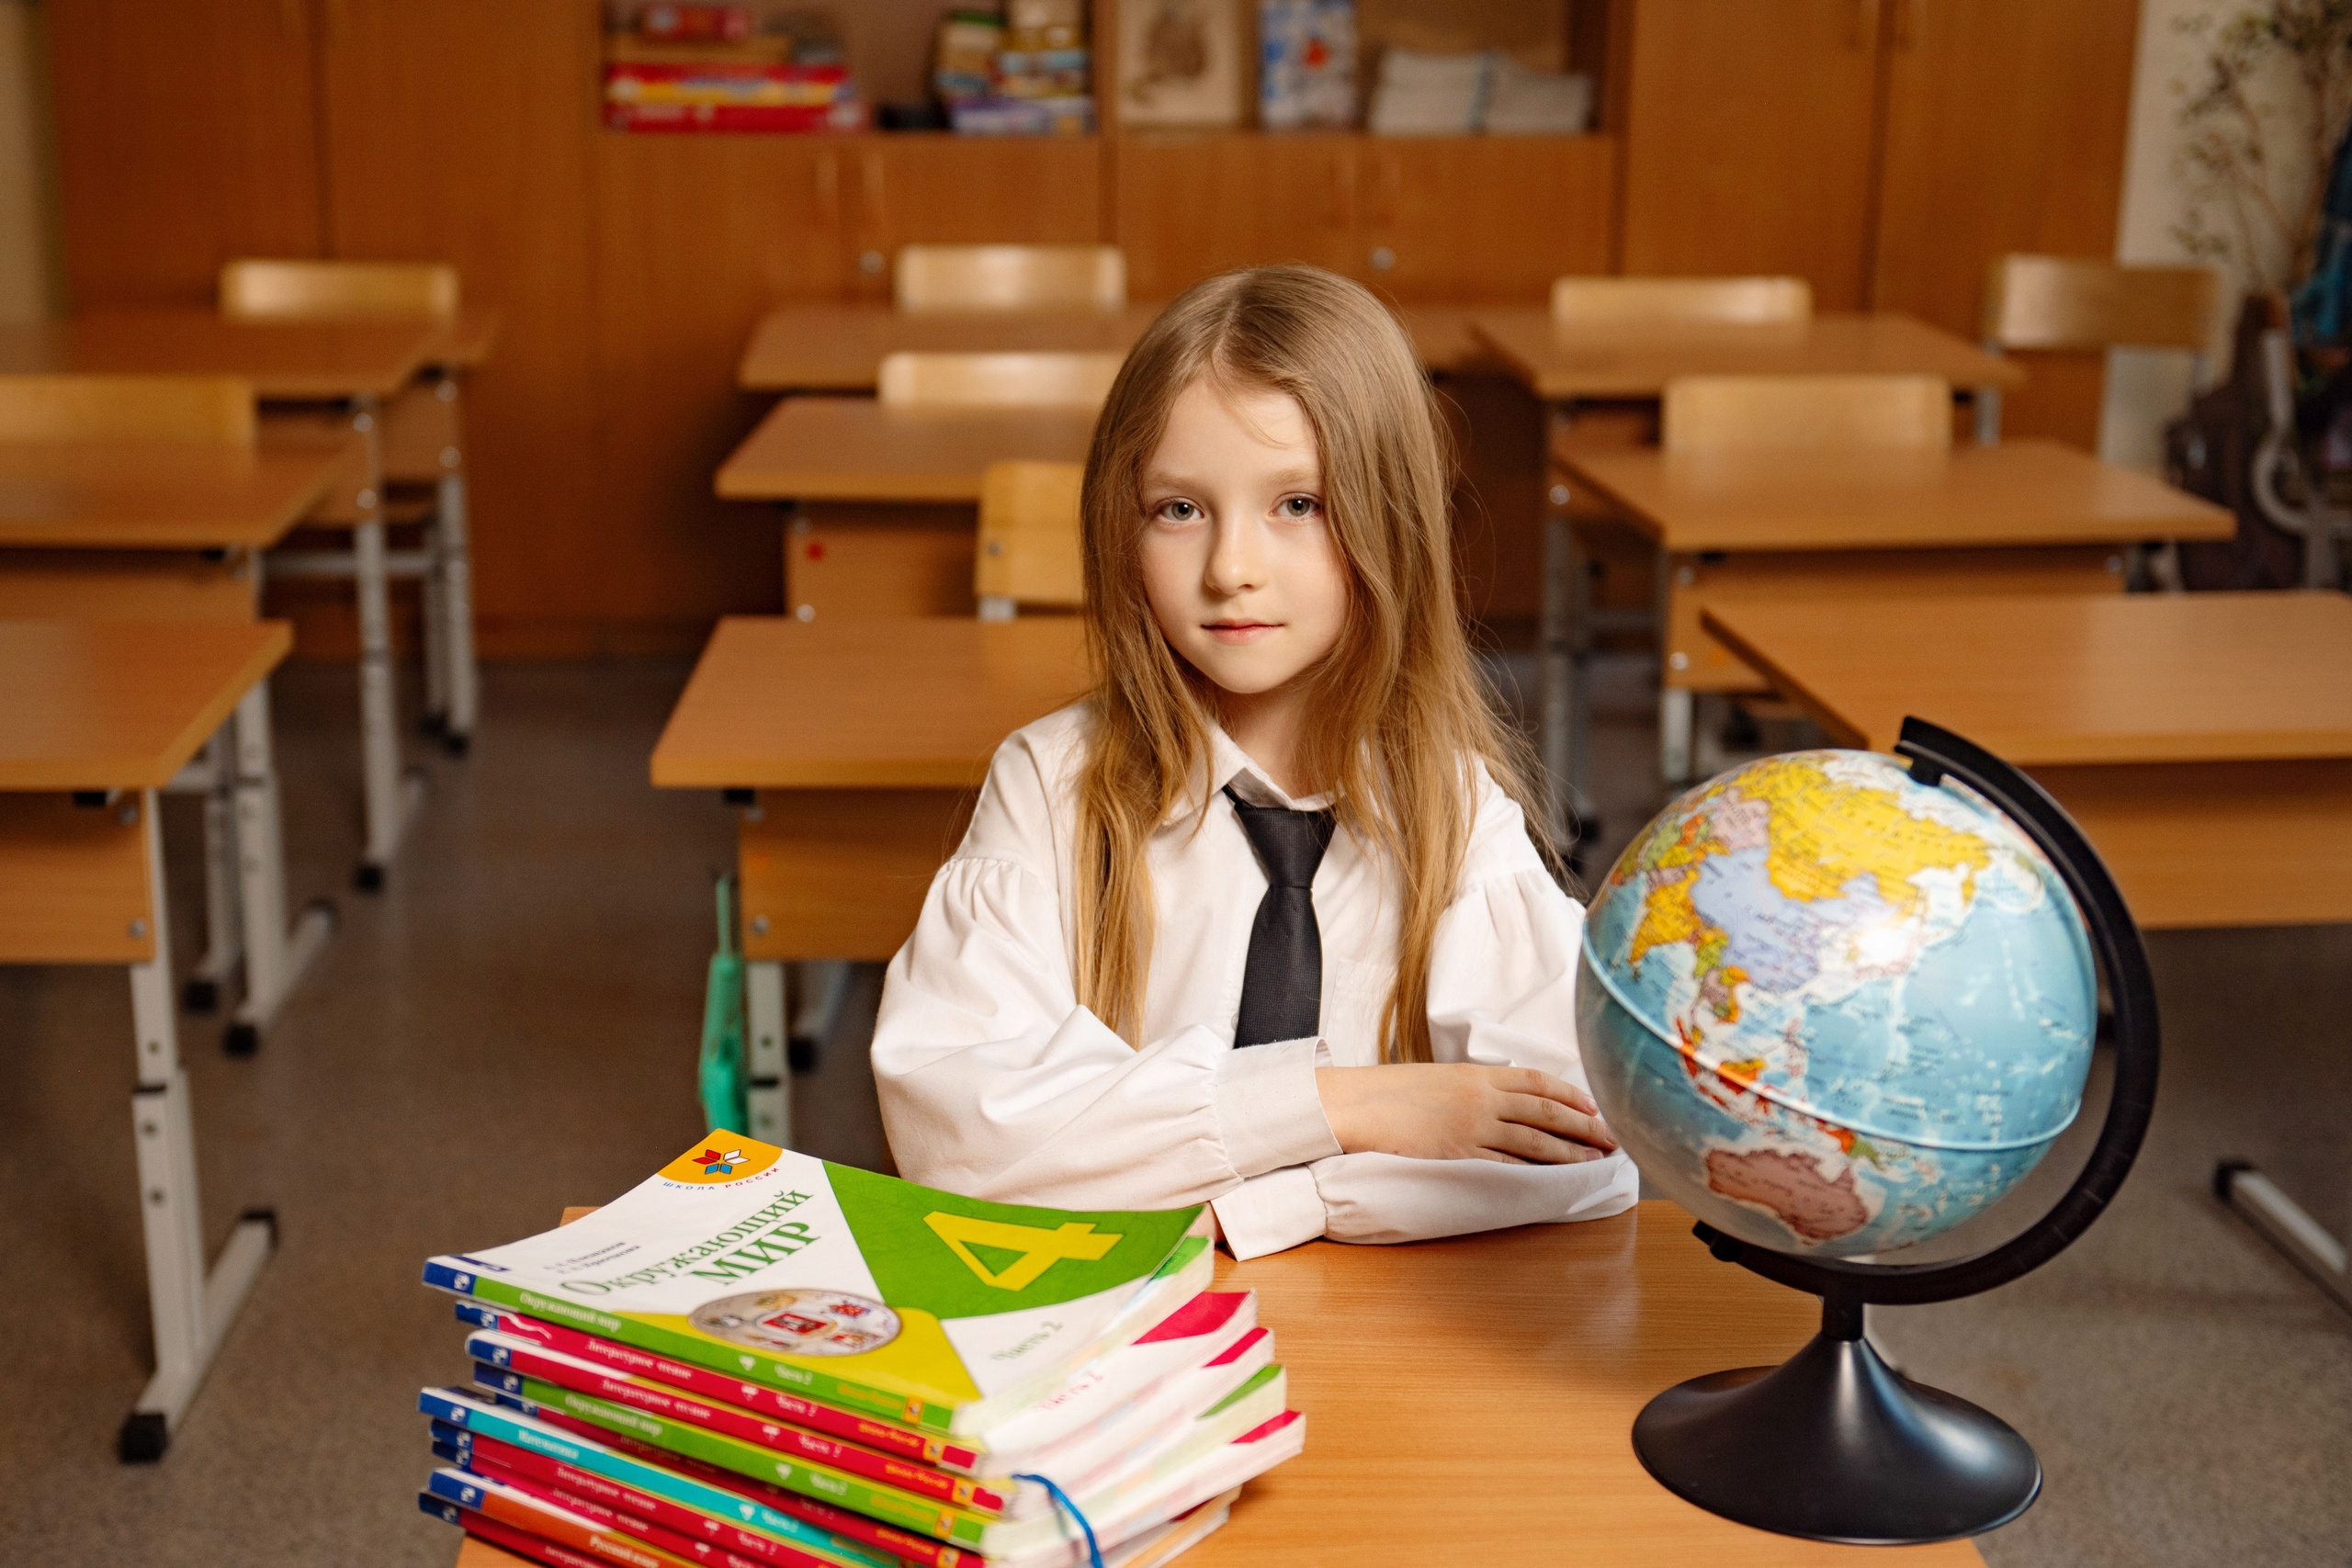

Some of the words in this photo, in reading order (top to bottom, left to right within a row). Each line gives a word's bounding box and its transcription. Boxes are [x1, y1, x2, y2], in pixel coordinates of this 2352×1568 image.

[662, 1181, 716, 1191] ШКОЛА
[724, 1167, 780, 1189] РОССИИ
[559, 1190, 814, 1296] Окружающий
[684, 1222, 821, 1286] МИР
[922, 1211, 1124, 1292] 4
